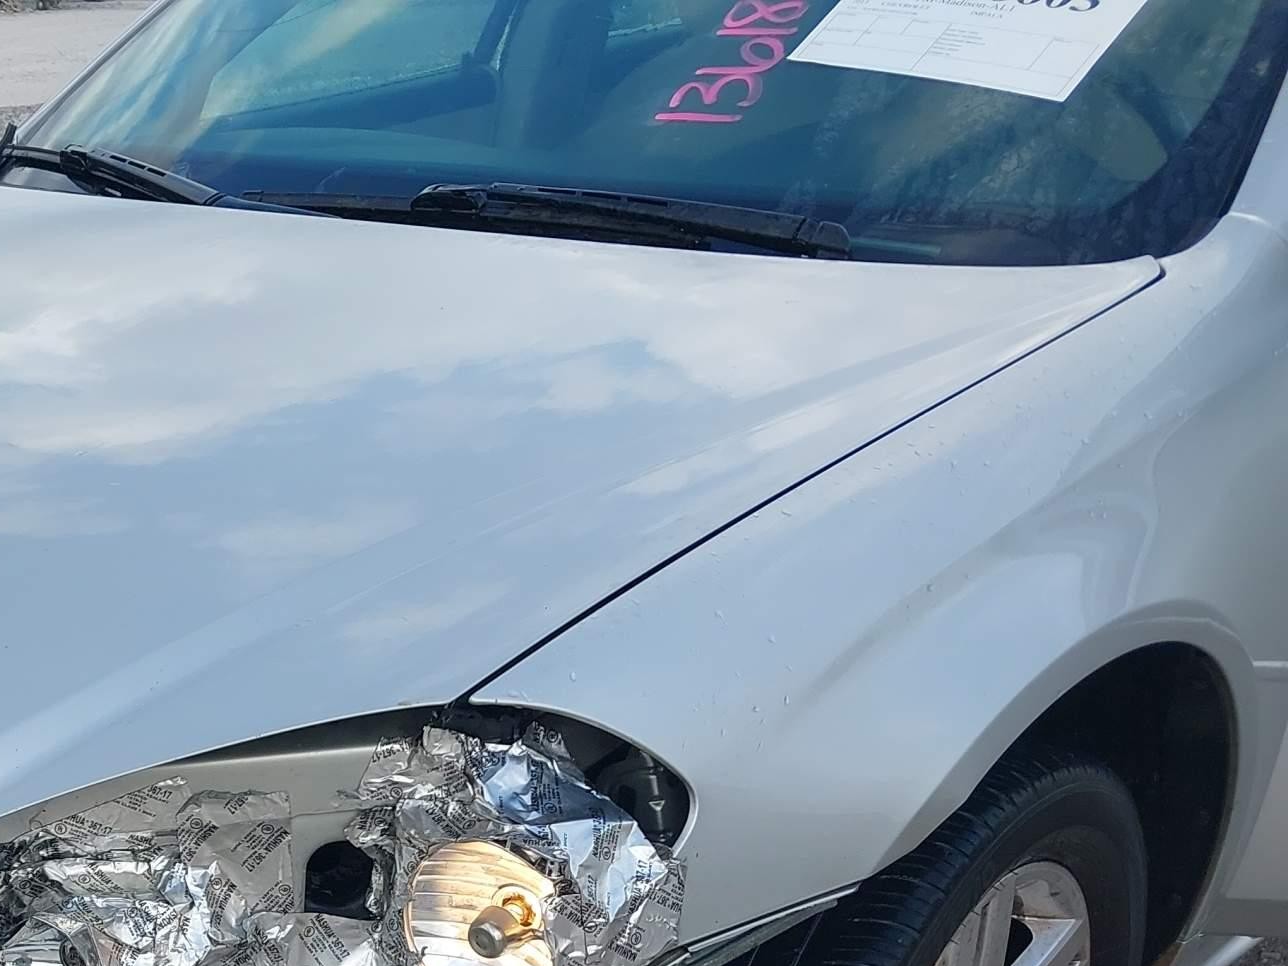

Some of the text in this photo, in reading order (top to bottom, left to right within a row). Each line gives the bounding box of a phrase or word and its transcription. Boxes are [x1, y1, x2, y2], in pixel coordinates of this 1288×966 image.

[193, 821, 219, 849] NASHUA
[263, 828, 291, 854] NASHUA
[217, 881, 237, 912] NASHUA
[313, 912, 335, 938] NASHUA
[612, 943, 638, 962] NASHUA
